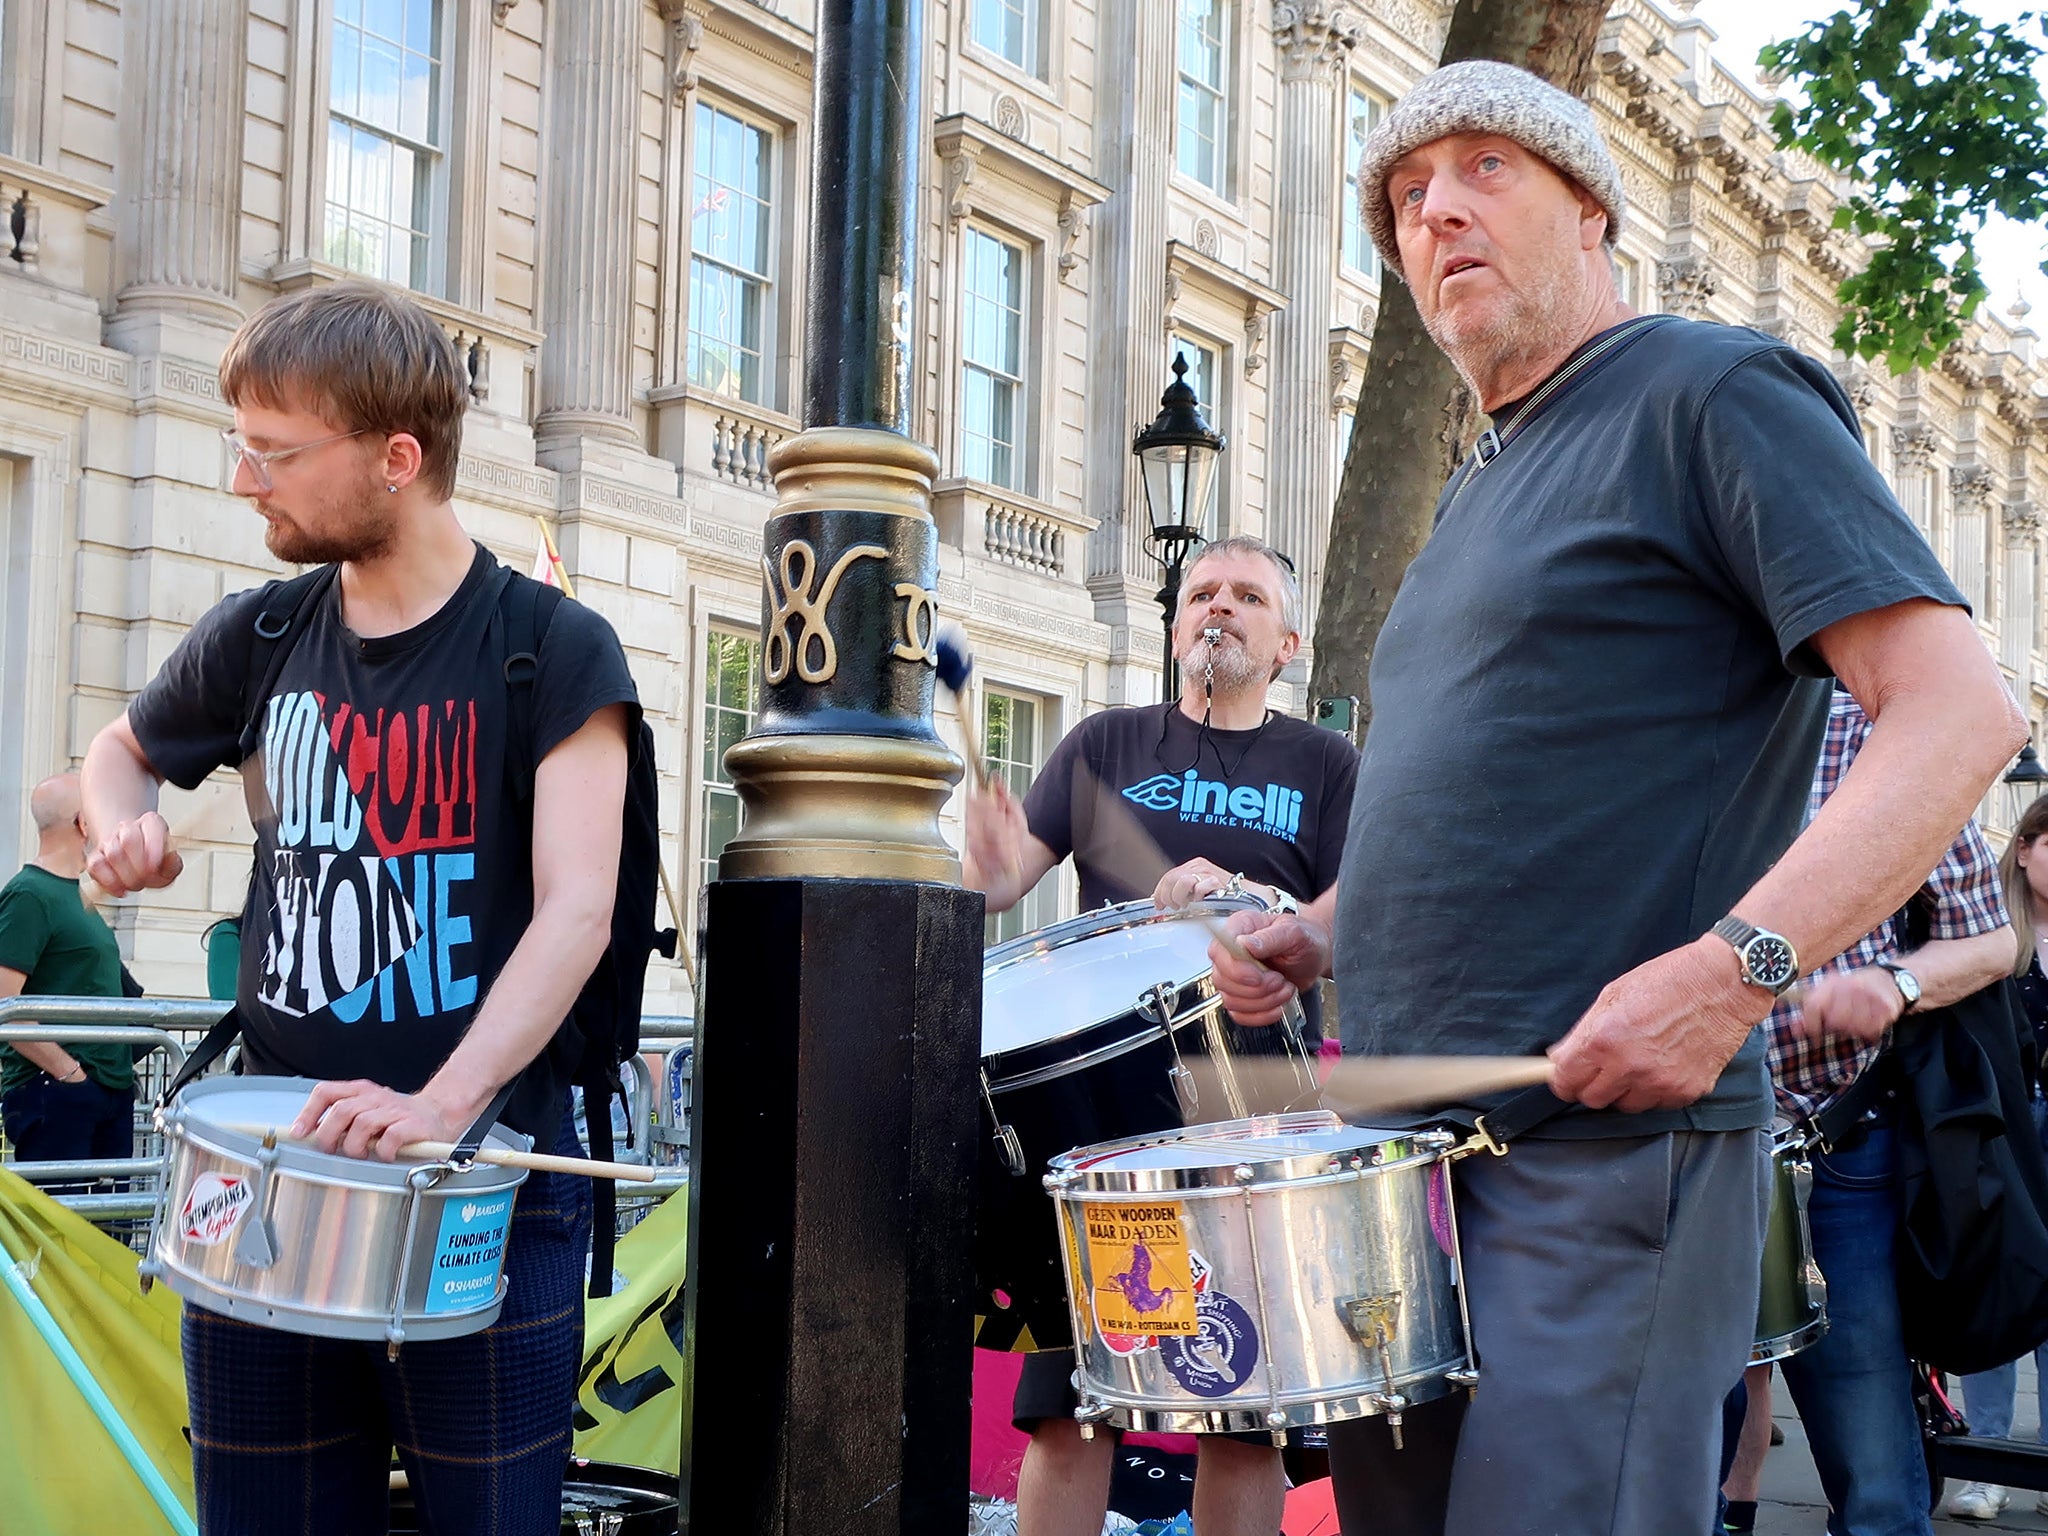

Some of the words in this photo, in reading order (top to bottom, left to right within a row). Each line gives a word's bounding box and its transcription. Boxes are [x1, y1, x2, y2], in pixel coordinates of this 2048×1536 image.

[1179, 812, 1199, 823] WE
[1204, 814, 1237, 827] BIKE
[1242, 818, 1297, 845] HARDER
[475, 1202, 505, 1217] BARCLAYS
[1087, 1208, 1116, 1221] GEEN
[1119, 1207, 1176, 1222] WOORDEN
[206, 1206, 239, 1242] light
[1120, 1224, 1179, 1240] DADEN
[448, 1230, 490, 1248] FUNDING
[492, 1226, 504, 1242] THE
[439, 1251, 482, 1269] CLIMATE
[483, 1243, 503, 1262] CRISIS
[1138, 1321, 1180, 1331] ROTTERDAM
[1181, 1321, 1191, 1331] CS
